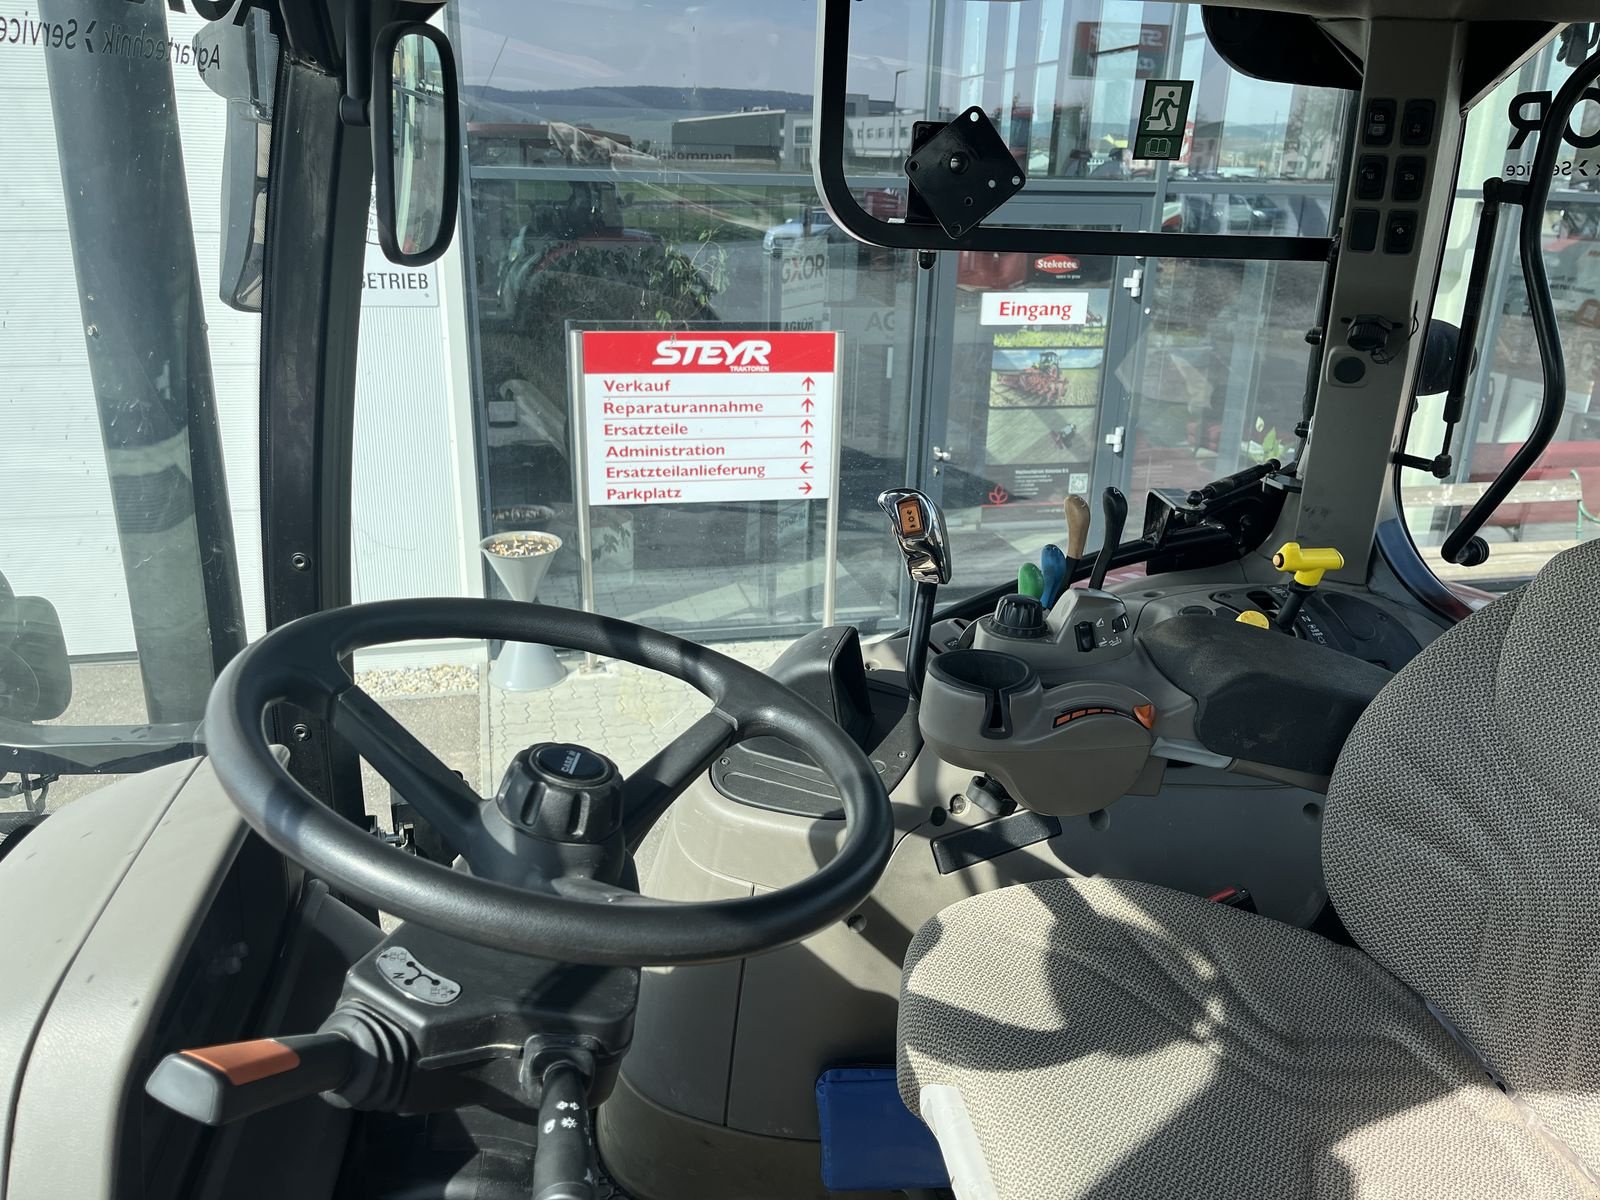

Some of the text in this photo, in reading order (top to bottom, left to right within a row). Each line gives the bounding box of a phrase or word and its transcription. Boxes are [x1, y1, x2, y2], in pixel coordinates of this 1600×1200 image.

[999, 301, 1072, 321] Eingang
[652, 339, 772, 366] STEYR
[603, 379, 671, 393] Verkauf
[603, 401, 764, 417] Reparaturannahme
[604, 422, 689, 436] Ersatzteile
[605, 444, 726, 458] Administration
[606, 464, 766, 479] Ersatzteilanlieferung
[607, 487, 682, 502] Parkplatz
